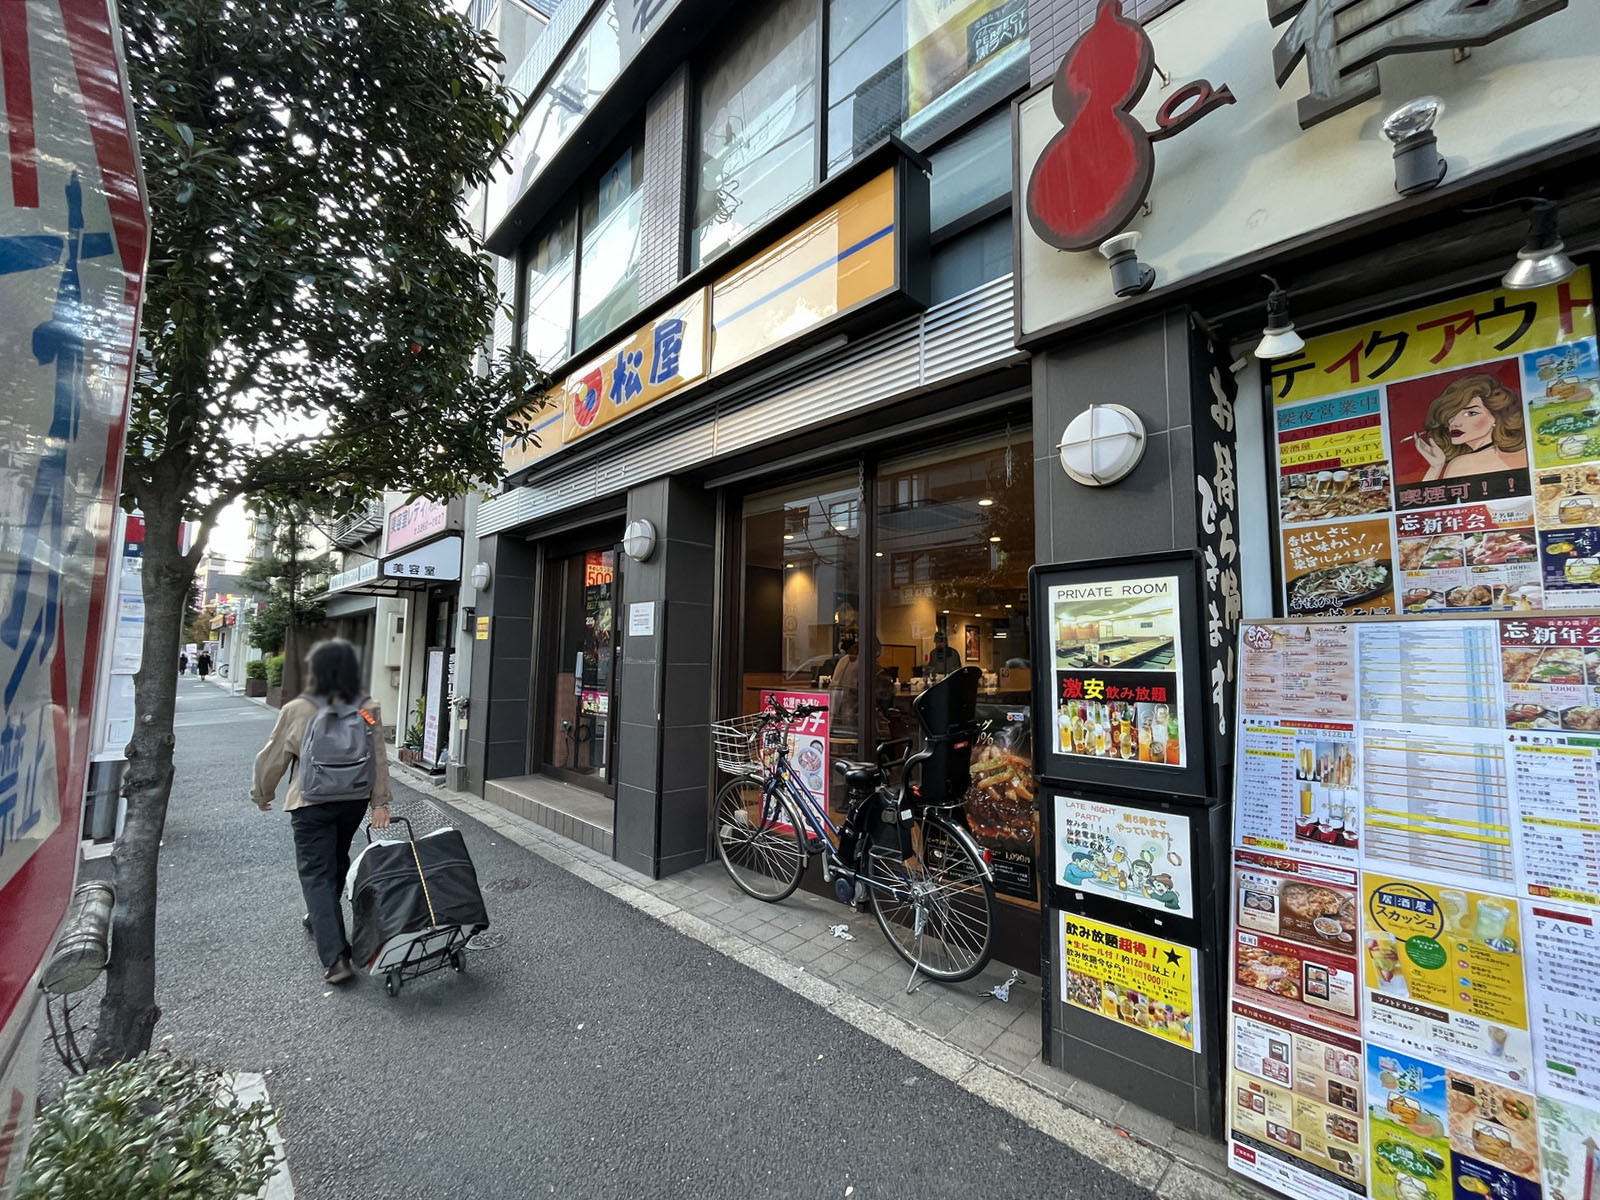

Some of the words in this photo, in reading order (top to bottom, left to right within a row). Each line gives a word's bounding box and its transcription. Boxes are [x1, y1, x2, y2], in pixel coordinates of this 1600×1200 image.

[1271, 283, 1595, 398] テイクアウト
[609, 317, 688, 406] 松屋
[1278, 396, 1378, 428] 深夜営業中
[1341, 454, 1383, 466] MUSIC
[1399, 513, 1486, 534] 忘新年会
[1288, 527, 1348, 547] 香ばしさと
[393, 563, 436, 577] 美容室
[1057, 586, 1113, 600] PRIVATE
[1122, 583, 1168, 596] ROOM
[1065, 801, 1086, 811] LATE
[1091, 805, 1117, 816] NIGHT
[1075, 812, 1102, 823] PARTY
[1376, 904, 1437, 930] スカッシュ
[1536, 919, 1600, 940] FACE
[1085, 961, 1098, 970] CAN
[1103, 967, 1127, 979] DRINK
[1132, 977, 1146, 986] ALL
[1153, 985, 1179, 997] ITEMS
